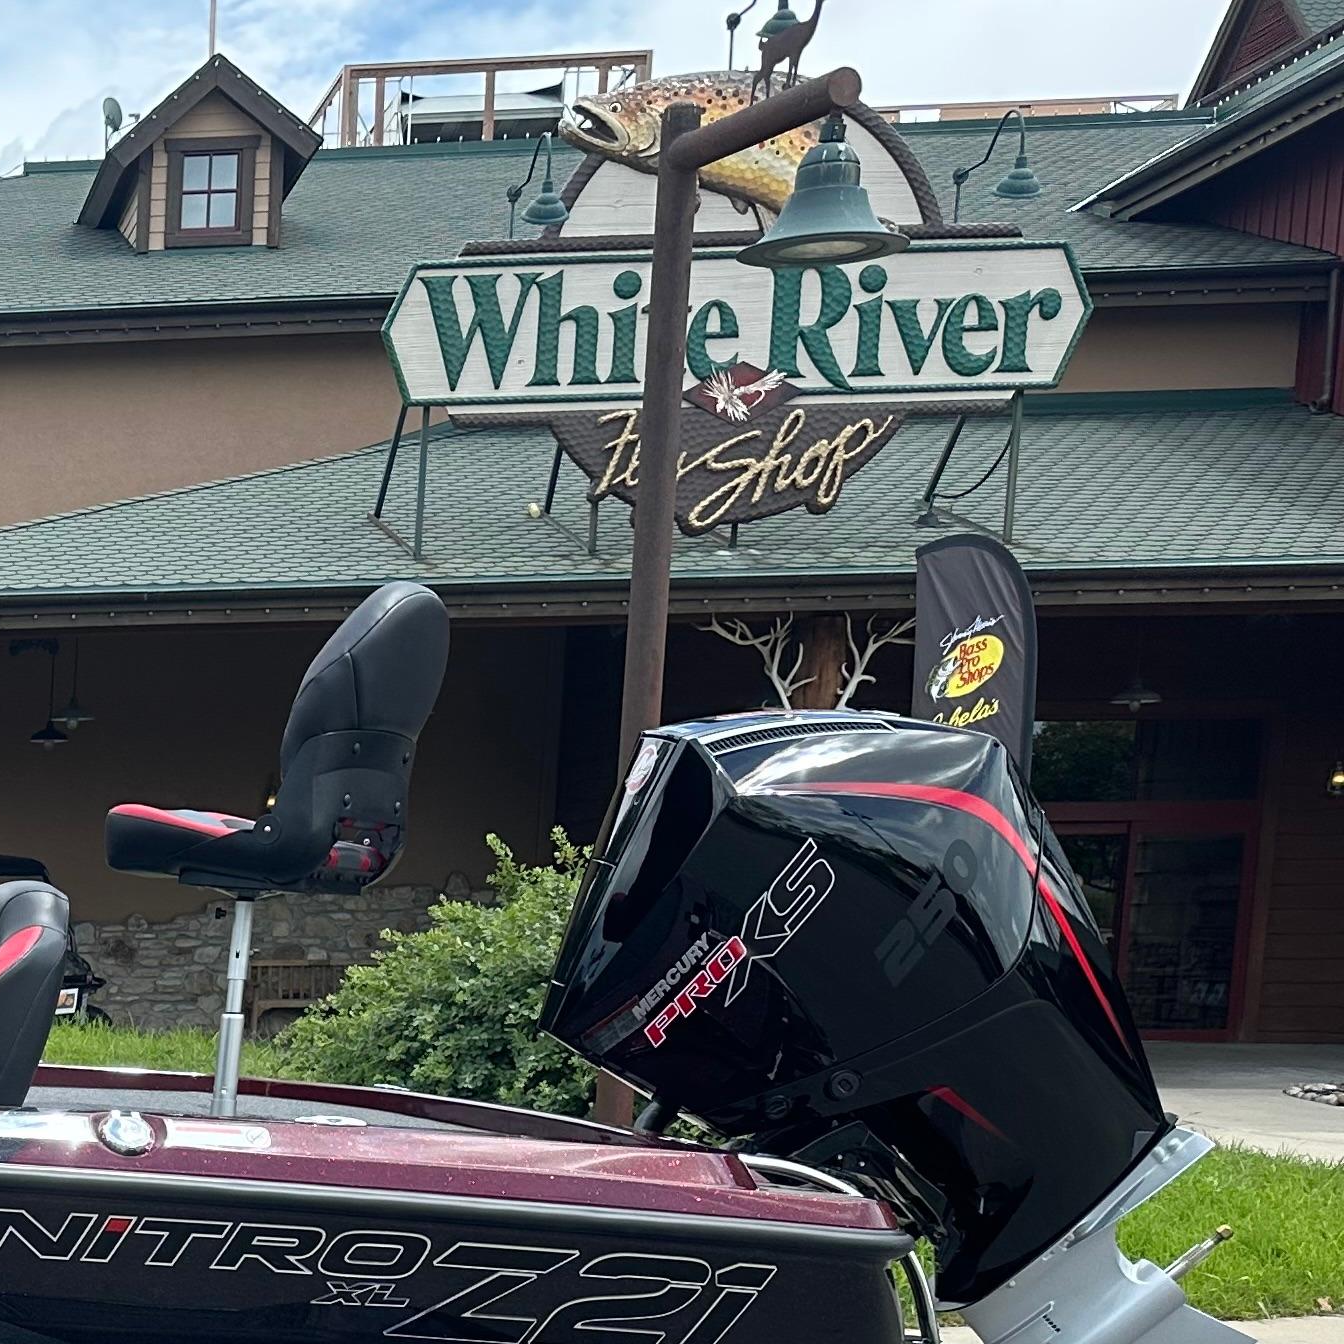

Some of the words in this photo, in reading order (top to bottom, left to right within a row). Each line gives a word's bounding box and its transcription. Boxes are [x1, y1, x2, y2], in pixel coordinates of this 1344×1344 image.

[417, 269, 740, 392] Whie
[766, 263, 1063, 392] River
[597, 408, 688, 497] Fl
[688, 408, 895, 528] Shop
[956, 663, 995, 689] Shops
[958, 655, 981, 674] Pro
[959, 638, 988, 660] Bass
[932, 697, 1000, 727] bela's
[874, 838, 978, 987] 250
[631, 931, 710, 1022] MERCURY
[643, 935, 748, 1049] PRO
[310, 1281, 411, 1308] XL
